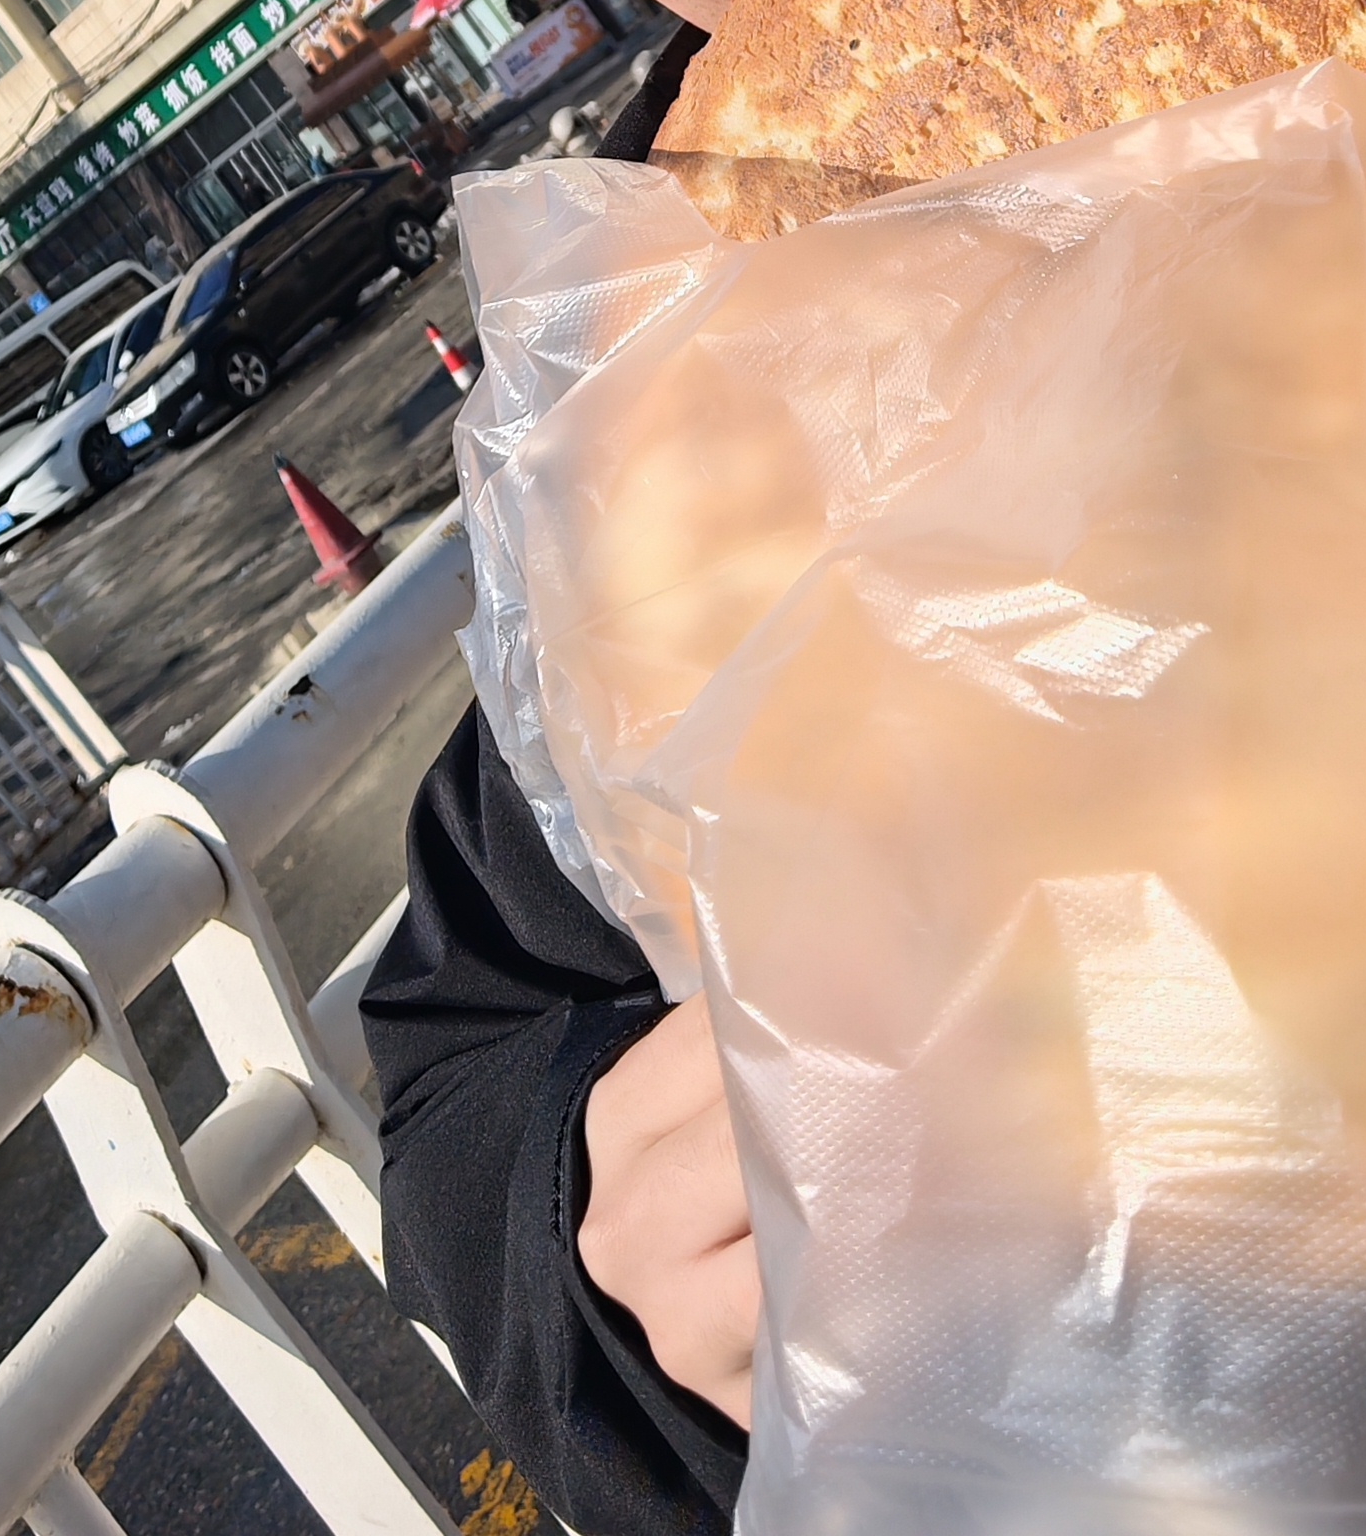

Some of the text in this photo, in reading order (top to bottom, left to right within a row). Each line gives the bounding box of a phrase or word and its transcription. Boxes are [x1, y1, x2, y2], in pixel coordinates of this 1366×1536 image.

[118, 101, 161, 148] 炒菜
[163, 63, 207, 111] 抓饭
[210, 21, 257, 73] 拌面
